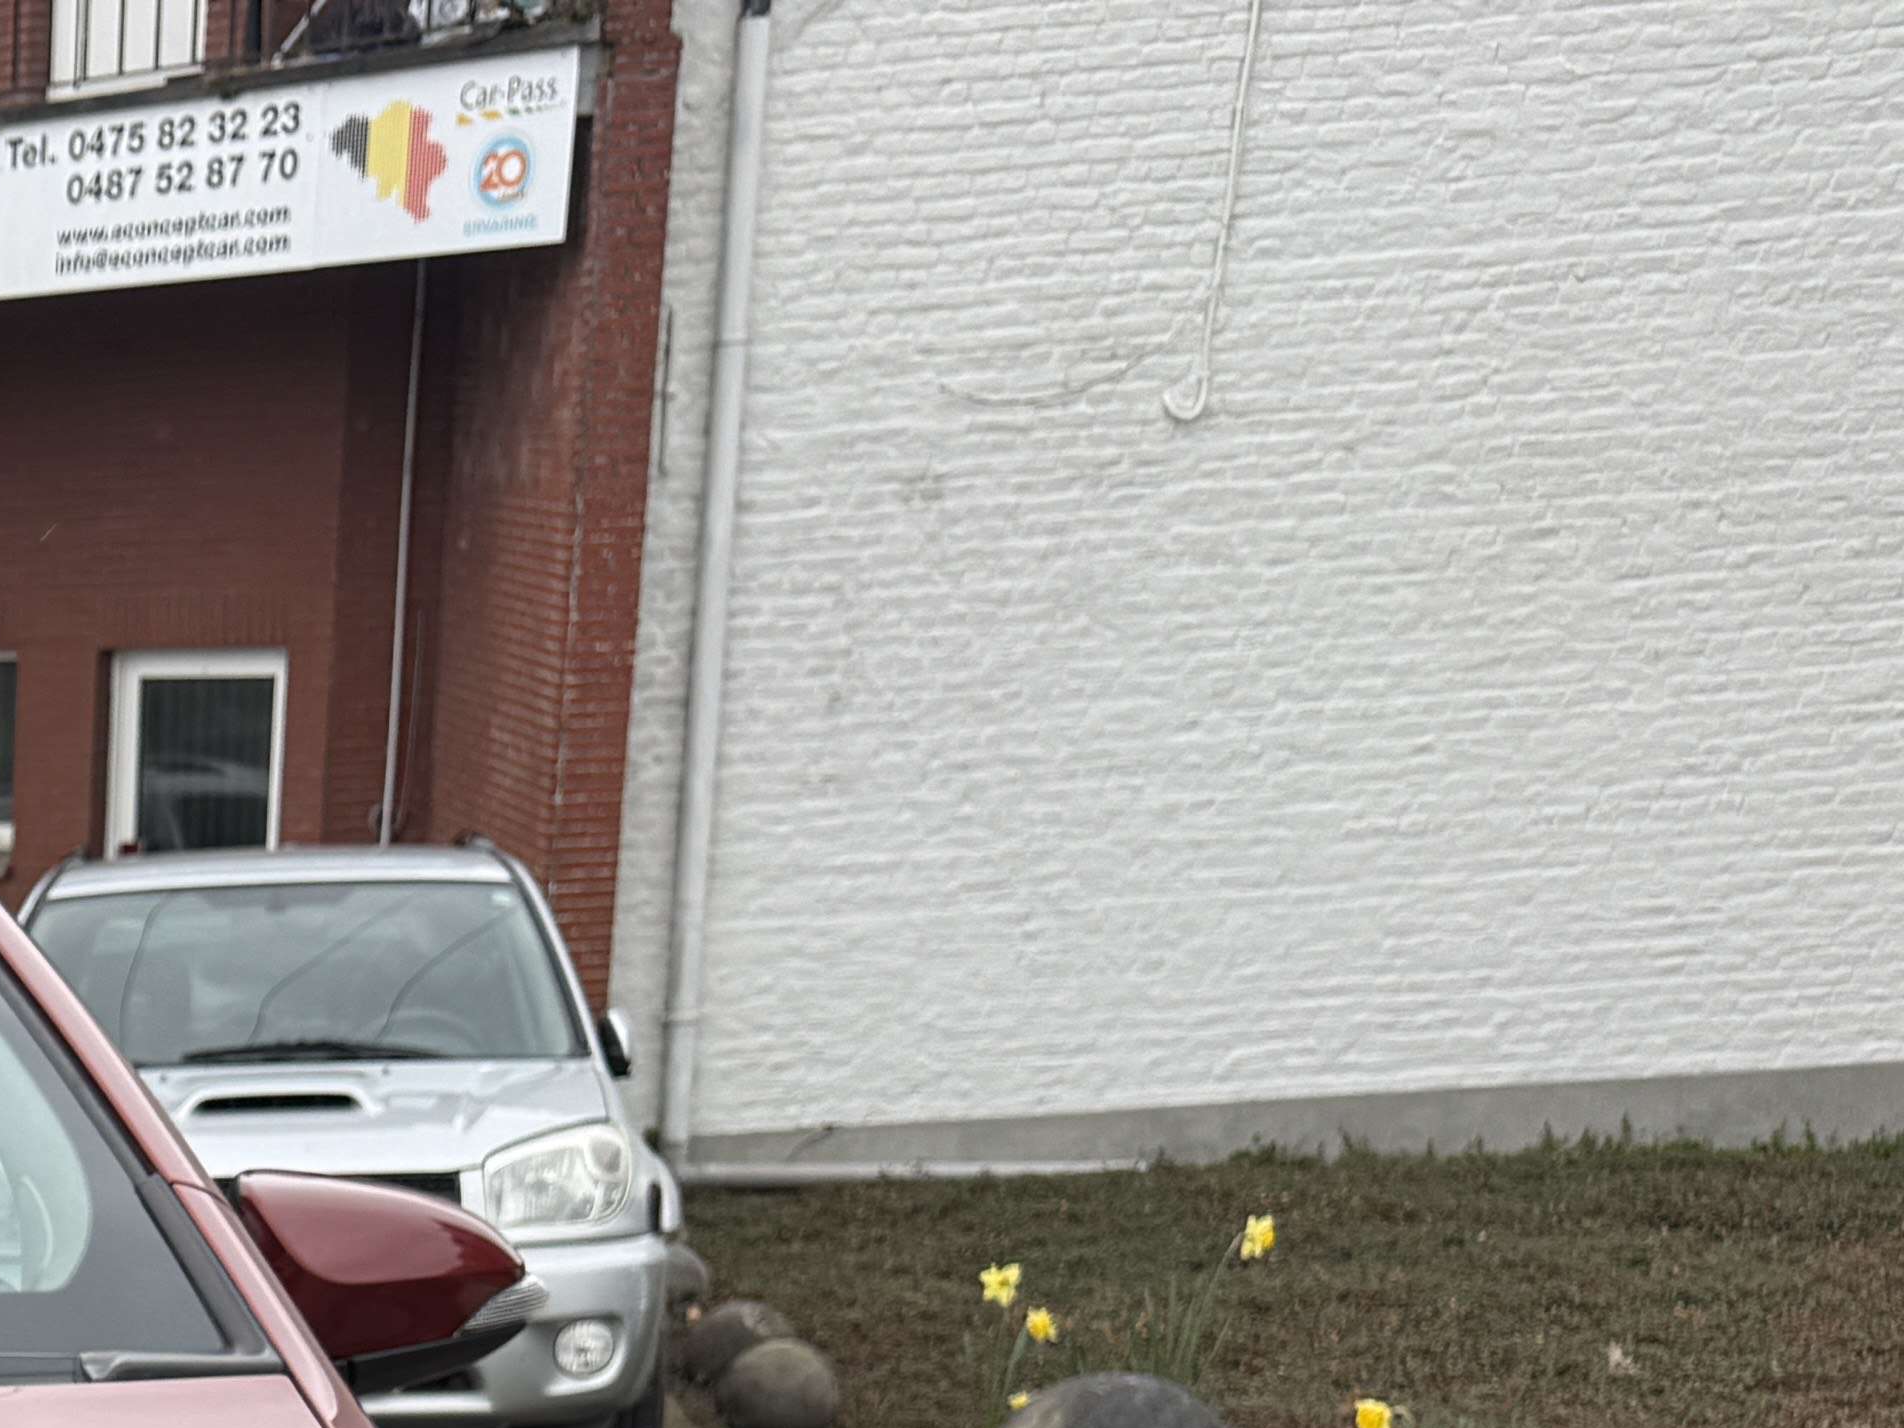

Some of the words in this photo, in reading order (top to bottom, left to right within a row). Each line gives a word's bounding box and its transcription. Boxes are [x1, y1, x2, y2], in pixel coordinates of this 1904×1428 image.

[460, 75, 557, 111] Car-Pass
[7, 131, 56, 170] Tel.
[68, 118, 146, 162] 0475
[156, 114, 195, 152] 82
[208, 108, 247, 145] 32
[259, 101, 301, 139] 23
[65, 164, 141, 205] 0487
[154, 160, 193, 196] 52
[205, 154, 244, 190] 87
[259, 149, 299, 184] 70
[480, 149, 527, 192] 20
[55, 205, 291, 247] www.econceptcar.com
[54, 233, 291, 276] info@econceptcar.com
